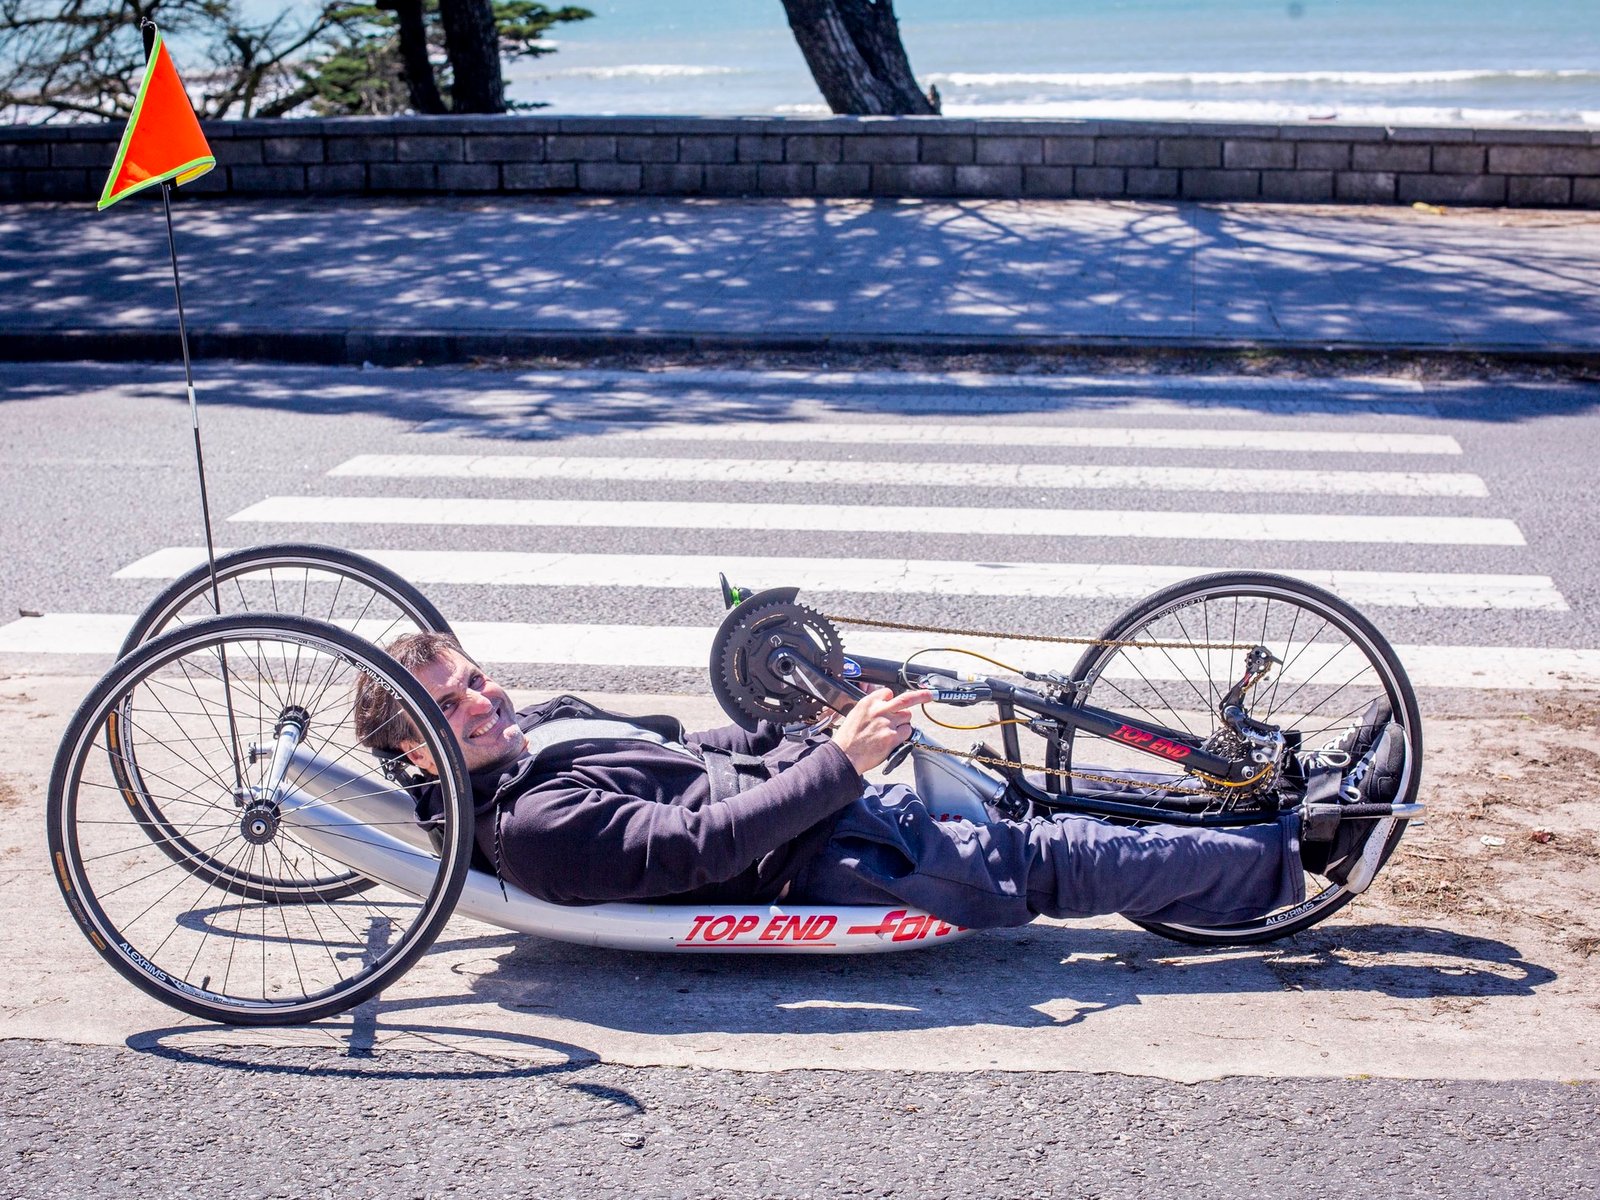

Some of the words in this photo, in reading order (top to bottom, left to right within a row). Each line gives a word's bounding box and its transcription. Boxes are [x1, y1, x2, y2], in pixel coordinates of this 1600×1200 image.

[354, 661, 402, 700] ALEXRIMS
[941, 692, 977, 701] SRAM
[1114, 725, 1153, 743] TOP
[1149, 738, 1191, 758] END
[685, 915, 760, 941] TOP
[758, 915, 838, 941] END
[1265, 901, 1315, 926] ALEXRIMS
[119, 942, 167, 982] ALEXRIMS
